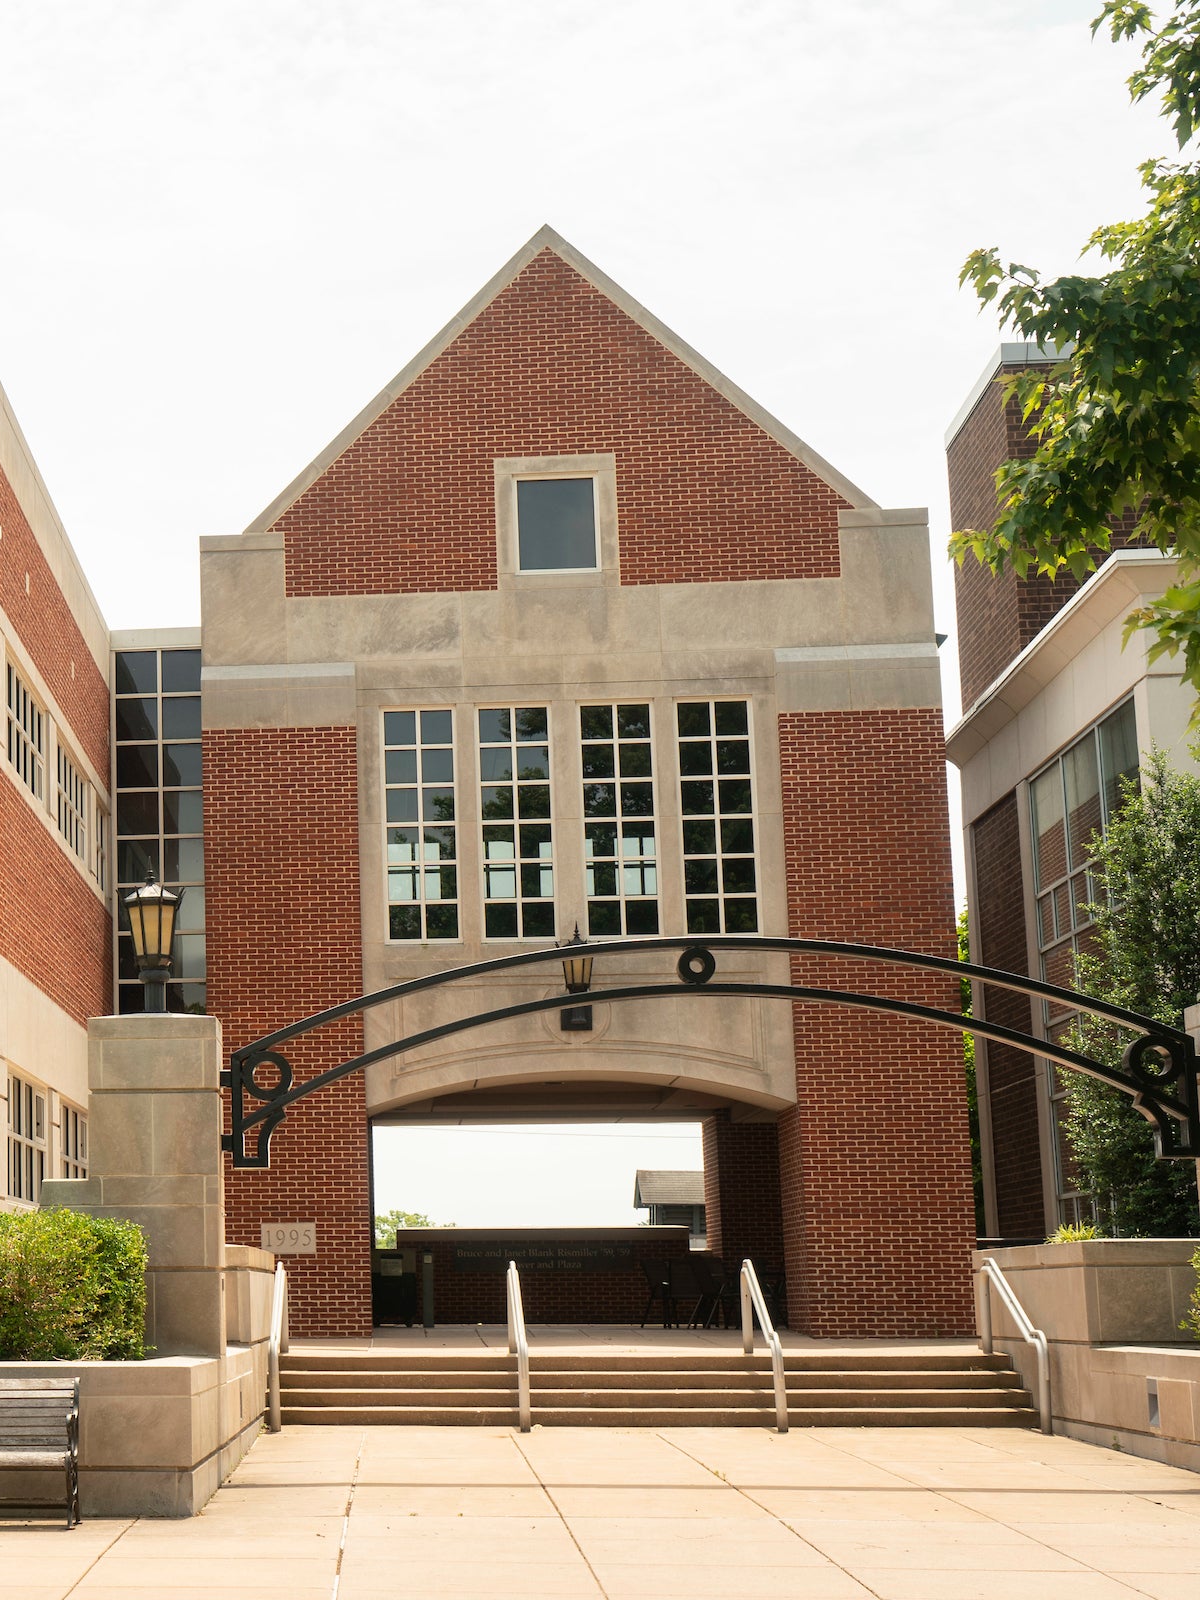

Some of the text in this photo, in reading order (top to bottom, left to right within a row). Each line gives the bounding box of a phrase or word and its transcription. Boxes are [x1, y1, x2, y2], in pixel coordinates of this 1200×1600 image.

[266, 1229, 312, 1247] 1995
[457, 1249, 482, 1257] Bruce
[484, 1249, 501, 1257] and
[504, 1249, 526, 1258] Janet
[528, 1248, 554, 1257] Blank
[557, 1248, 598, 1257] Rismiller
[537, 1260, 554, 1269] and
[557, 1260, 582, 1269] Plaza
